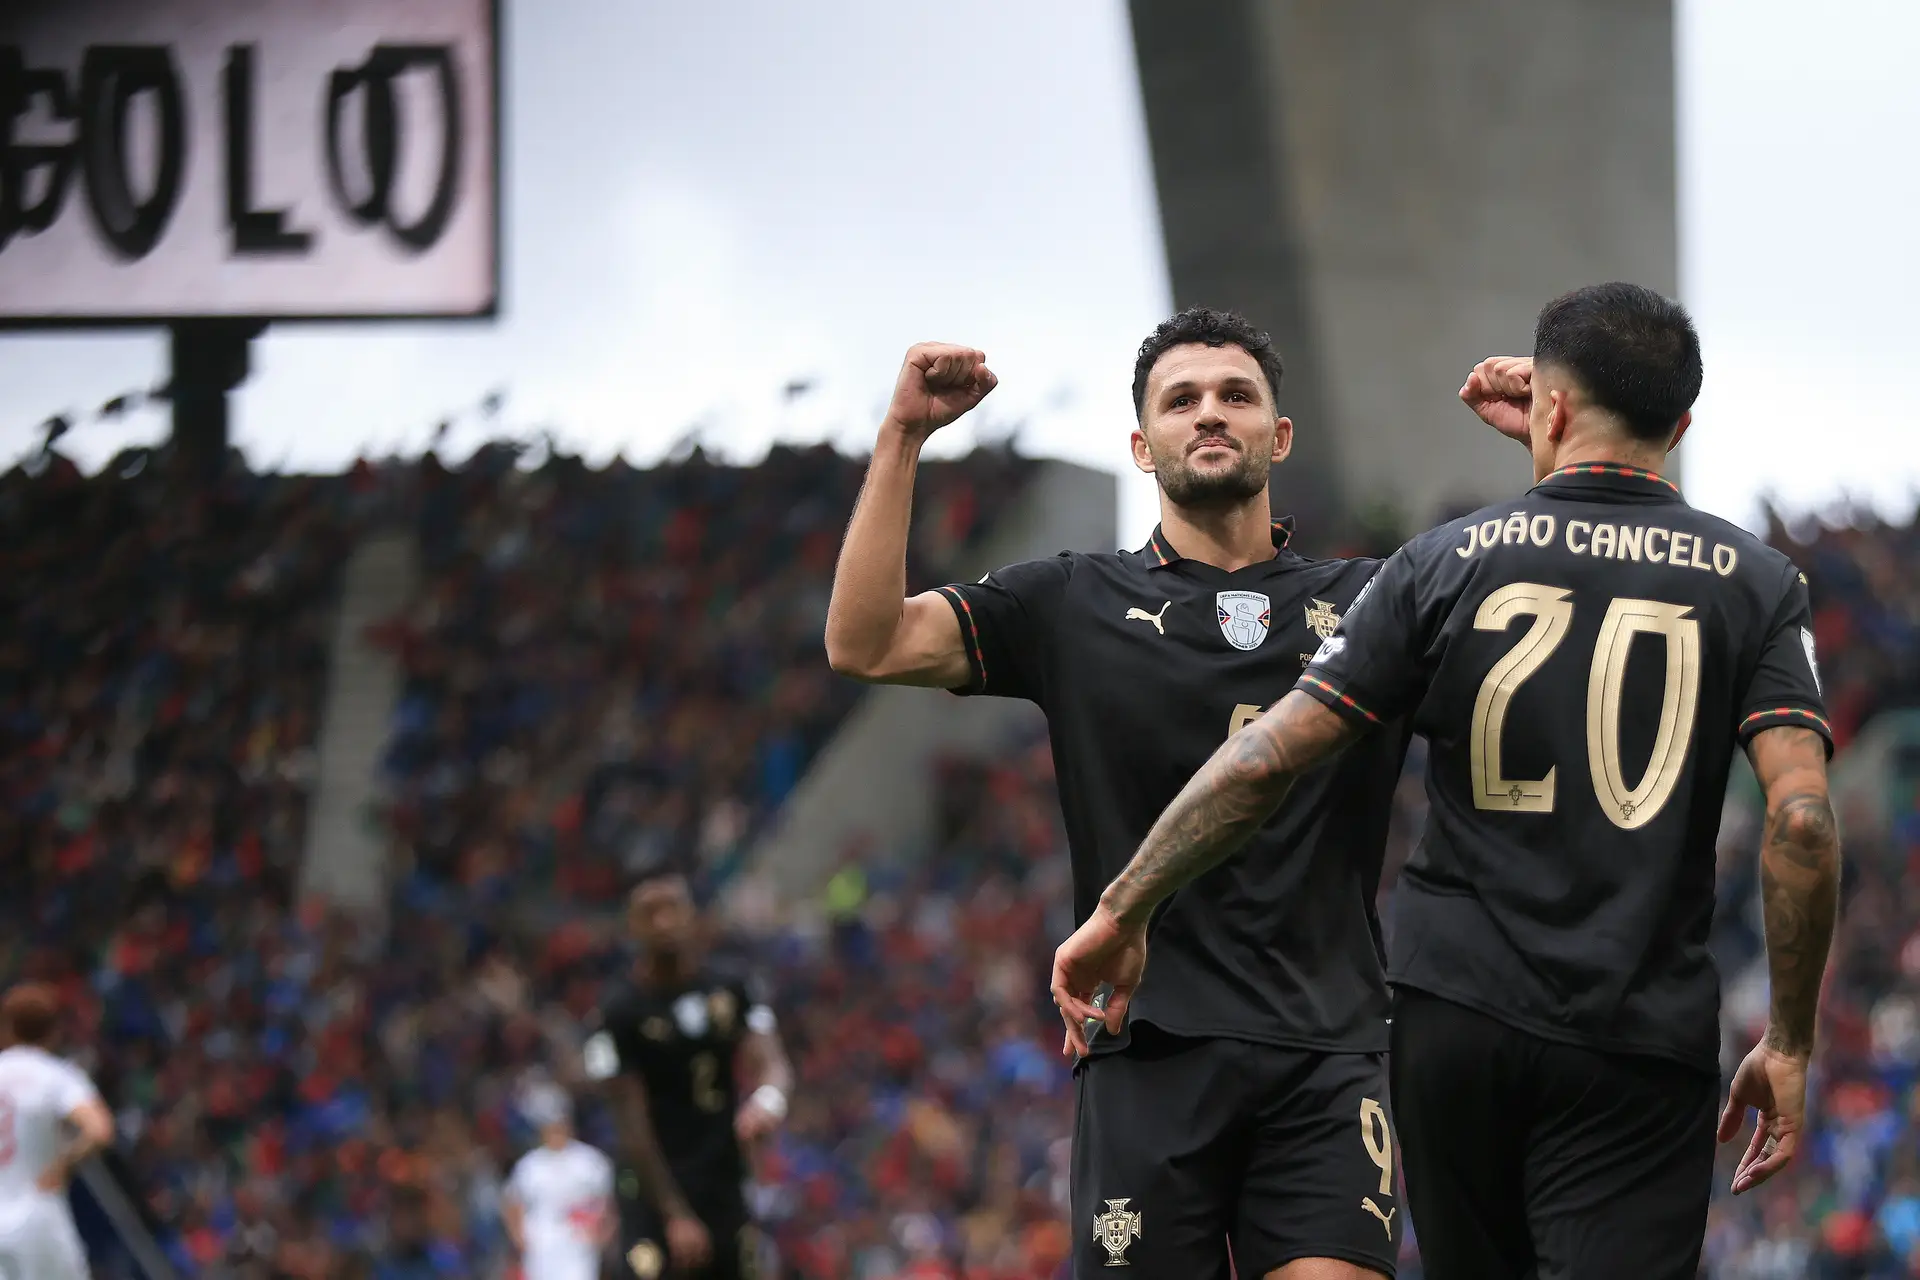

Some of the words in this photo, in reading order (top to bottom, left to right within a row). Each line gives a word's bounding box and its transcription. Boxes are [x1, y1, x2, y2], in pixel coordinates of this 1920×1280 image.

[1456, 511, 1555, 558] JOÃO
[1565, 519, 1738, 577] CANCELO
[1470, 582, 1699, 830] 20
[1359, 1097, 1392, 1196] 9
